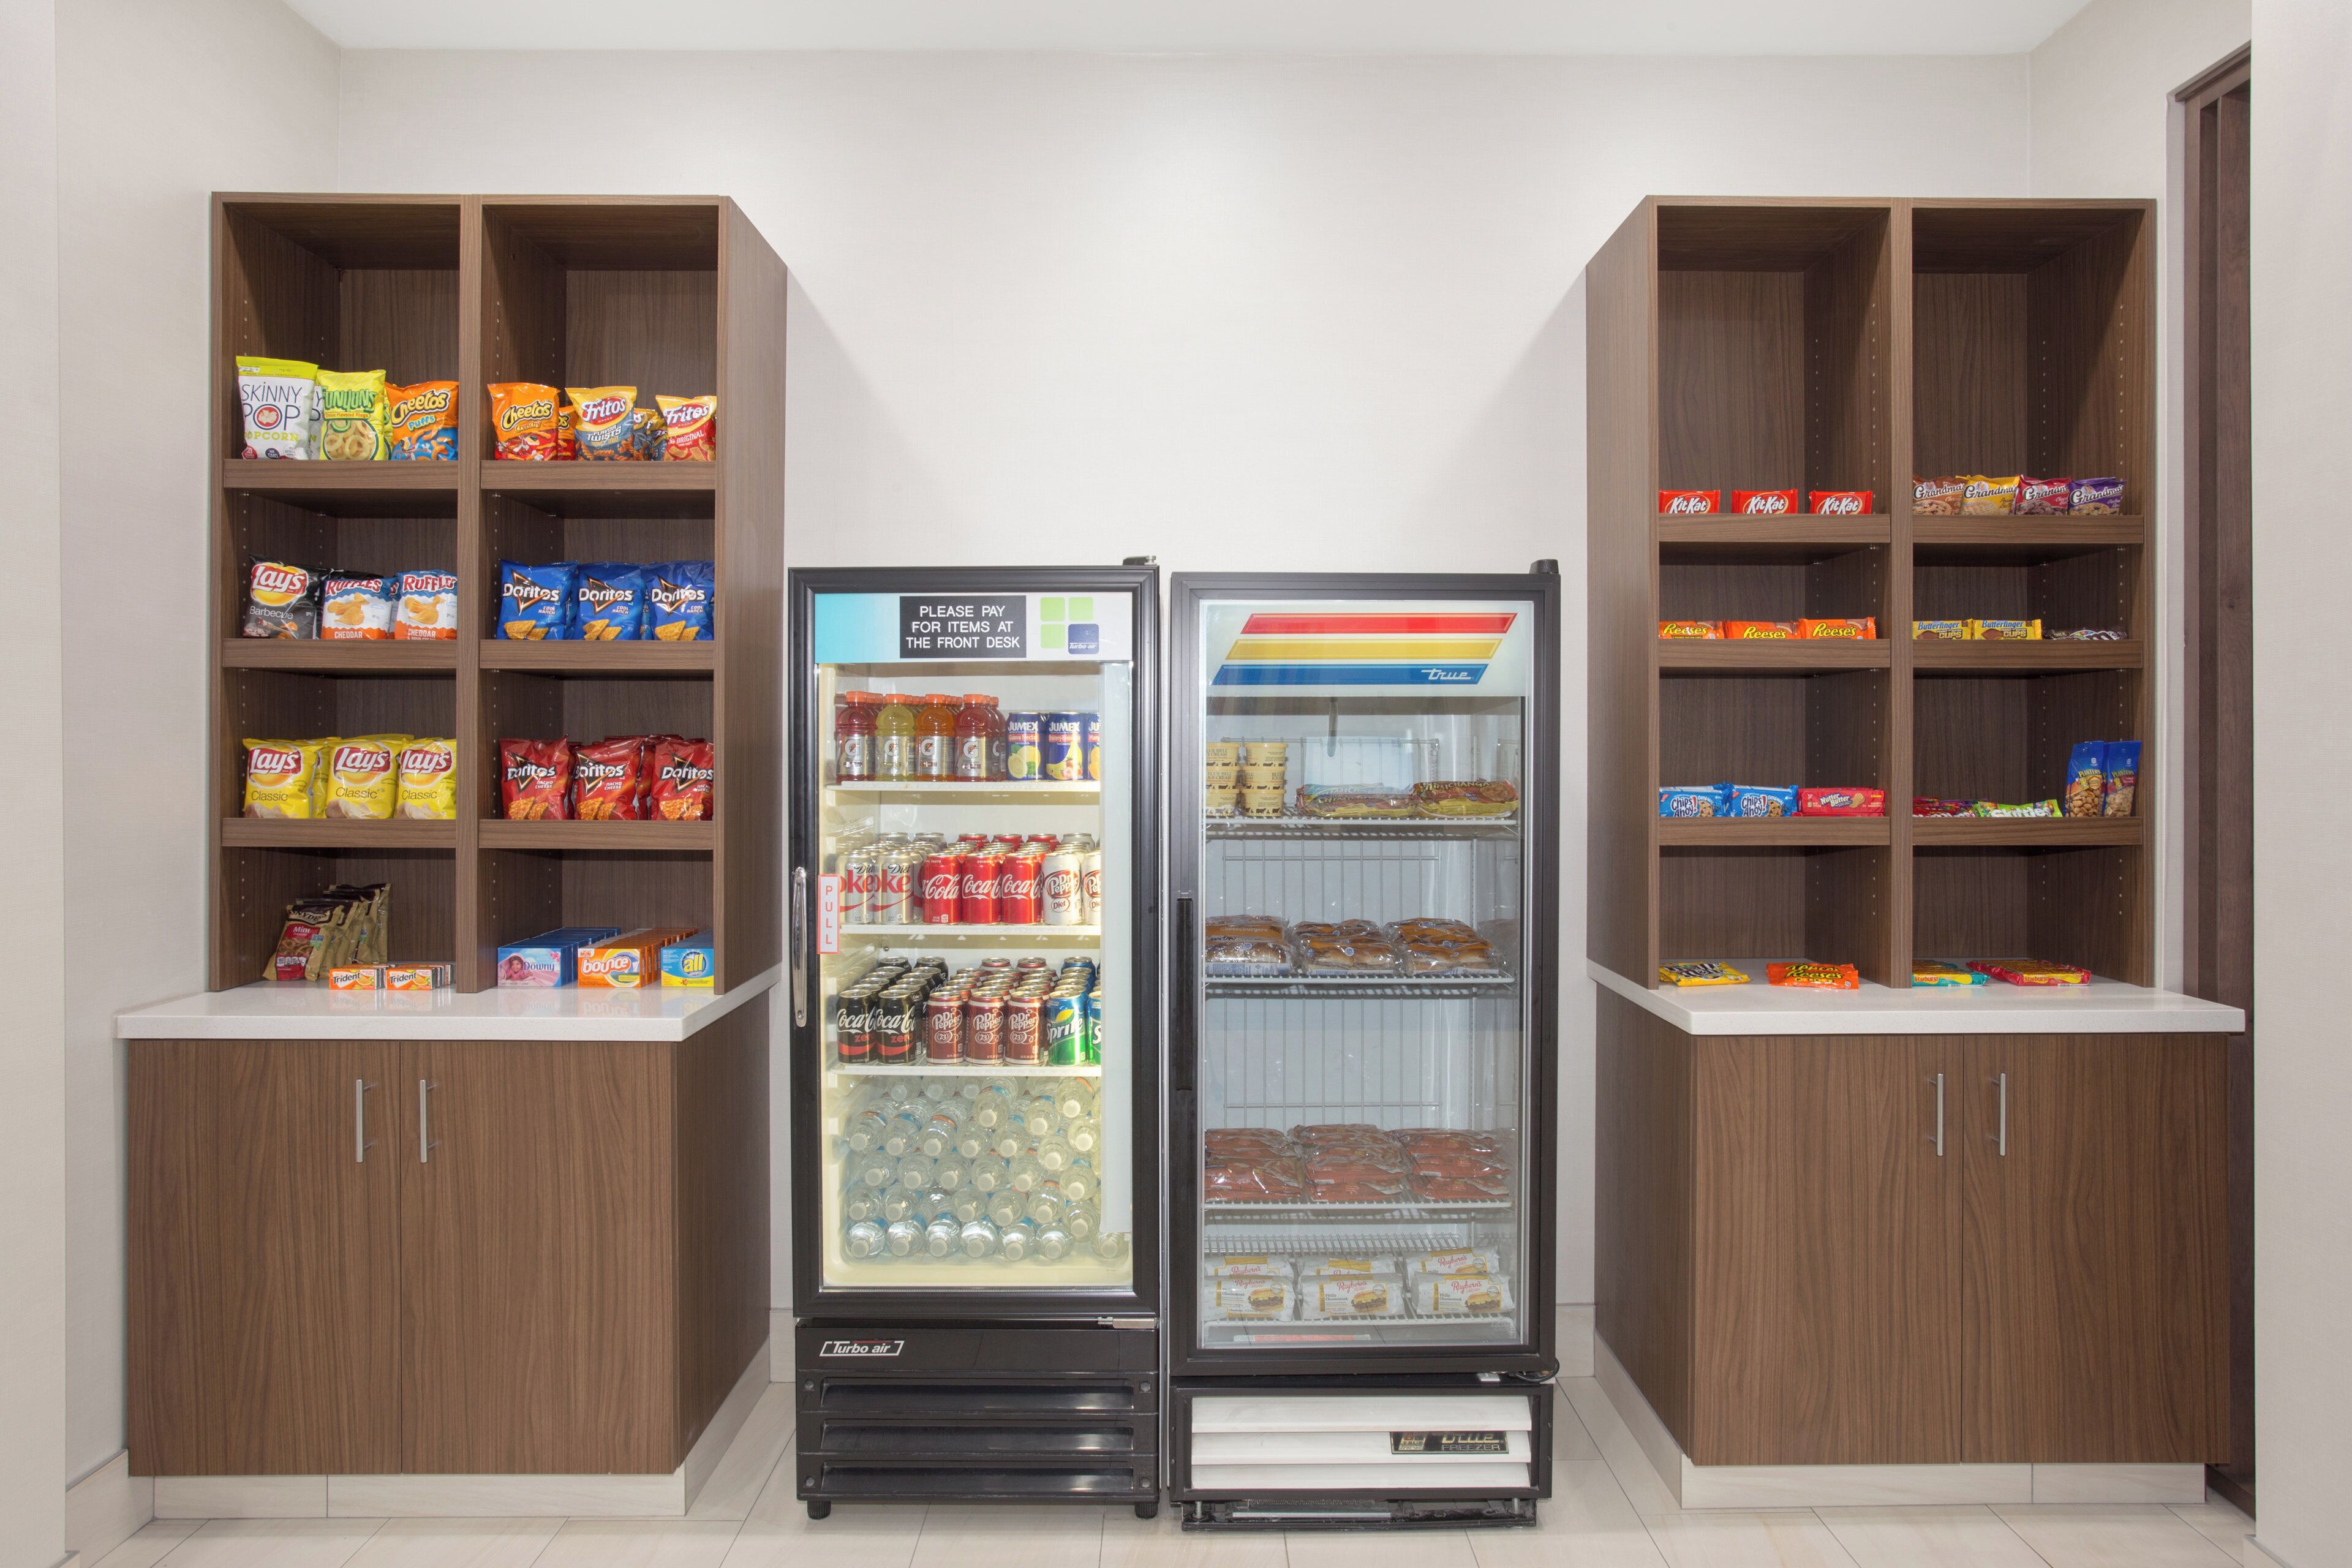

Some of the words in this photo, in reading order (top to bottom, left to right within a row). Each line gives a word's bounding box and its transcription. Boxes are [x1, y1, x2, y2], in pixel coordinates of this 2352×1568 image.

[242, 382, 303, 403] SKINNY
[391, 390, 448, 424] Cheetos
[582, 398, 625, 421] Fritos
[243, 403, 301, 431] POP
[502, 401, 552, 431] Cheetos
[663, 404, 709, 424] Fritos
[408, 415, 435, 431] Puffs
[514, 421, 541, 432] Crunchy
[593, 424, 617, 435] FLAVOR
[587, 426, 621, 441] TWISTS
[676, 430, 704, 443] ORIGINAL
[1964, 485, 2017, 499] Grandma's
[2022, 485, 2067, 500] Grandm
[252, 566, 305, 592] Lay's
[502, 583, 560, 601] Doritos
[579, 588, 633, 601] Doritos
[652, 588, 705, 602] Doritos
[250, 606, 293, 619] Barbecue
[919, 605, 974, 617] PLEASE
[982, 605, 1006, 617] PAY
[912, 622, 940, 633] FOR
[948, 621, 990, 633] ITEMS
[997, 621, 1014, 633] AT
[1663, 623, 1708, 635] Reese's
[1812, 622, 1856, 638] Reese's
[1918, 622, 1959, 630] Butterfinger
[1981, 620, 2024, 629] Butterfinger
[407, 628, 435, 638] CHEDDAR
[1743, 626, 1786, 639] Reese's
[906, 637, 930, 649] THE
[938, 637, 980, 649] FRONT
[986, 636, 1020, 648] DESK
[1422, 668, 1471, 680] true
[1008, 721, 1038, 731] JUMEX
[1049, 721, 1080, 732] JUMEX
[250, 749, 299, 774] Lay's
[336, 748, 389, 773] Lay's
[402, 750, 450, 774] Lay's
[508, 764, 556, 780] Doritos
[662, 766, 714, 780] Doritos
[251, 790, 288, 801] Classic
[336, 787, 377, 799] Classic
[402, 790, 437, 800] Classic
[1820, 793, 1839, 804] Nutter
[1671, 797, 1692, 810] Chips
[1741, 796, 1762, 810] Chips
[1830, 796, 1850, 806] Butter
[888, 863, 911, 874] Diet
[1053, 900, 1066, 910] Diet
[524, 962, 554, 971] Downy
[582, 957, 630, 974] bounce
[684, 954, 704, 973] all
[332, 973, 360, 984] Trident
[389, 973, 417, 985] Trident
[1785, 970, 1845, 979] Reese's
[935, 1014, 961, 1030] Pepper
[943, 1012, 954, 1021] Dr
[976, 1014, 1002, 1030] Pepper
[984, 1012, 995, 1021] Dr
[1011, 1014, 1037, 1030] Pepper
[1018, 1012, 1029, 1021] Dr
[1047, 1015, 1083, 1043] Sprite
[854, 1034, 875, 1042] zero
[891, 1034, 913, 1042] zero
[1438, 1254, 1468, 1268] Raybern's
[1231, 1265, 1261, 1275] Raybern's
[1336, 1281, 1367, 1293] Raybern's
[1452, 1281, 1482, 1294] Raybern's
[832, 1341, 869, 1354] Turbo
[872, 1343, 891, 1353] air
